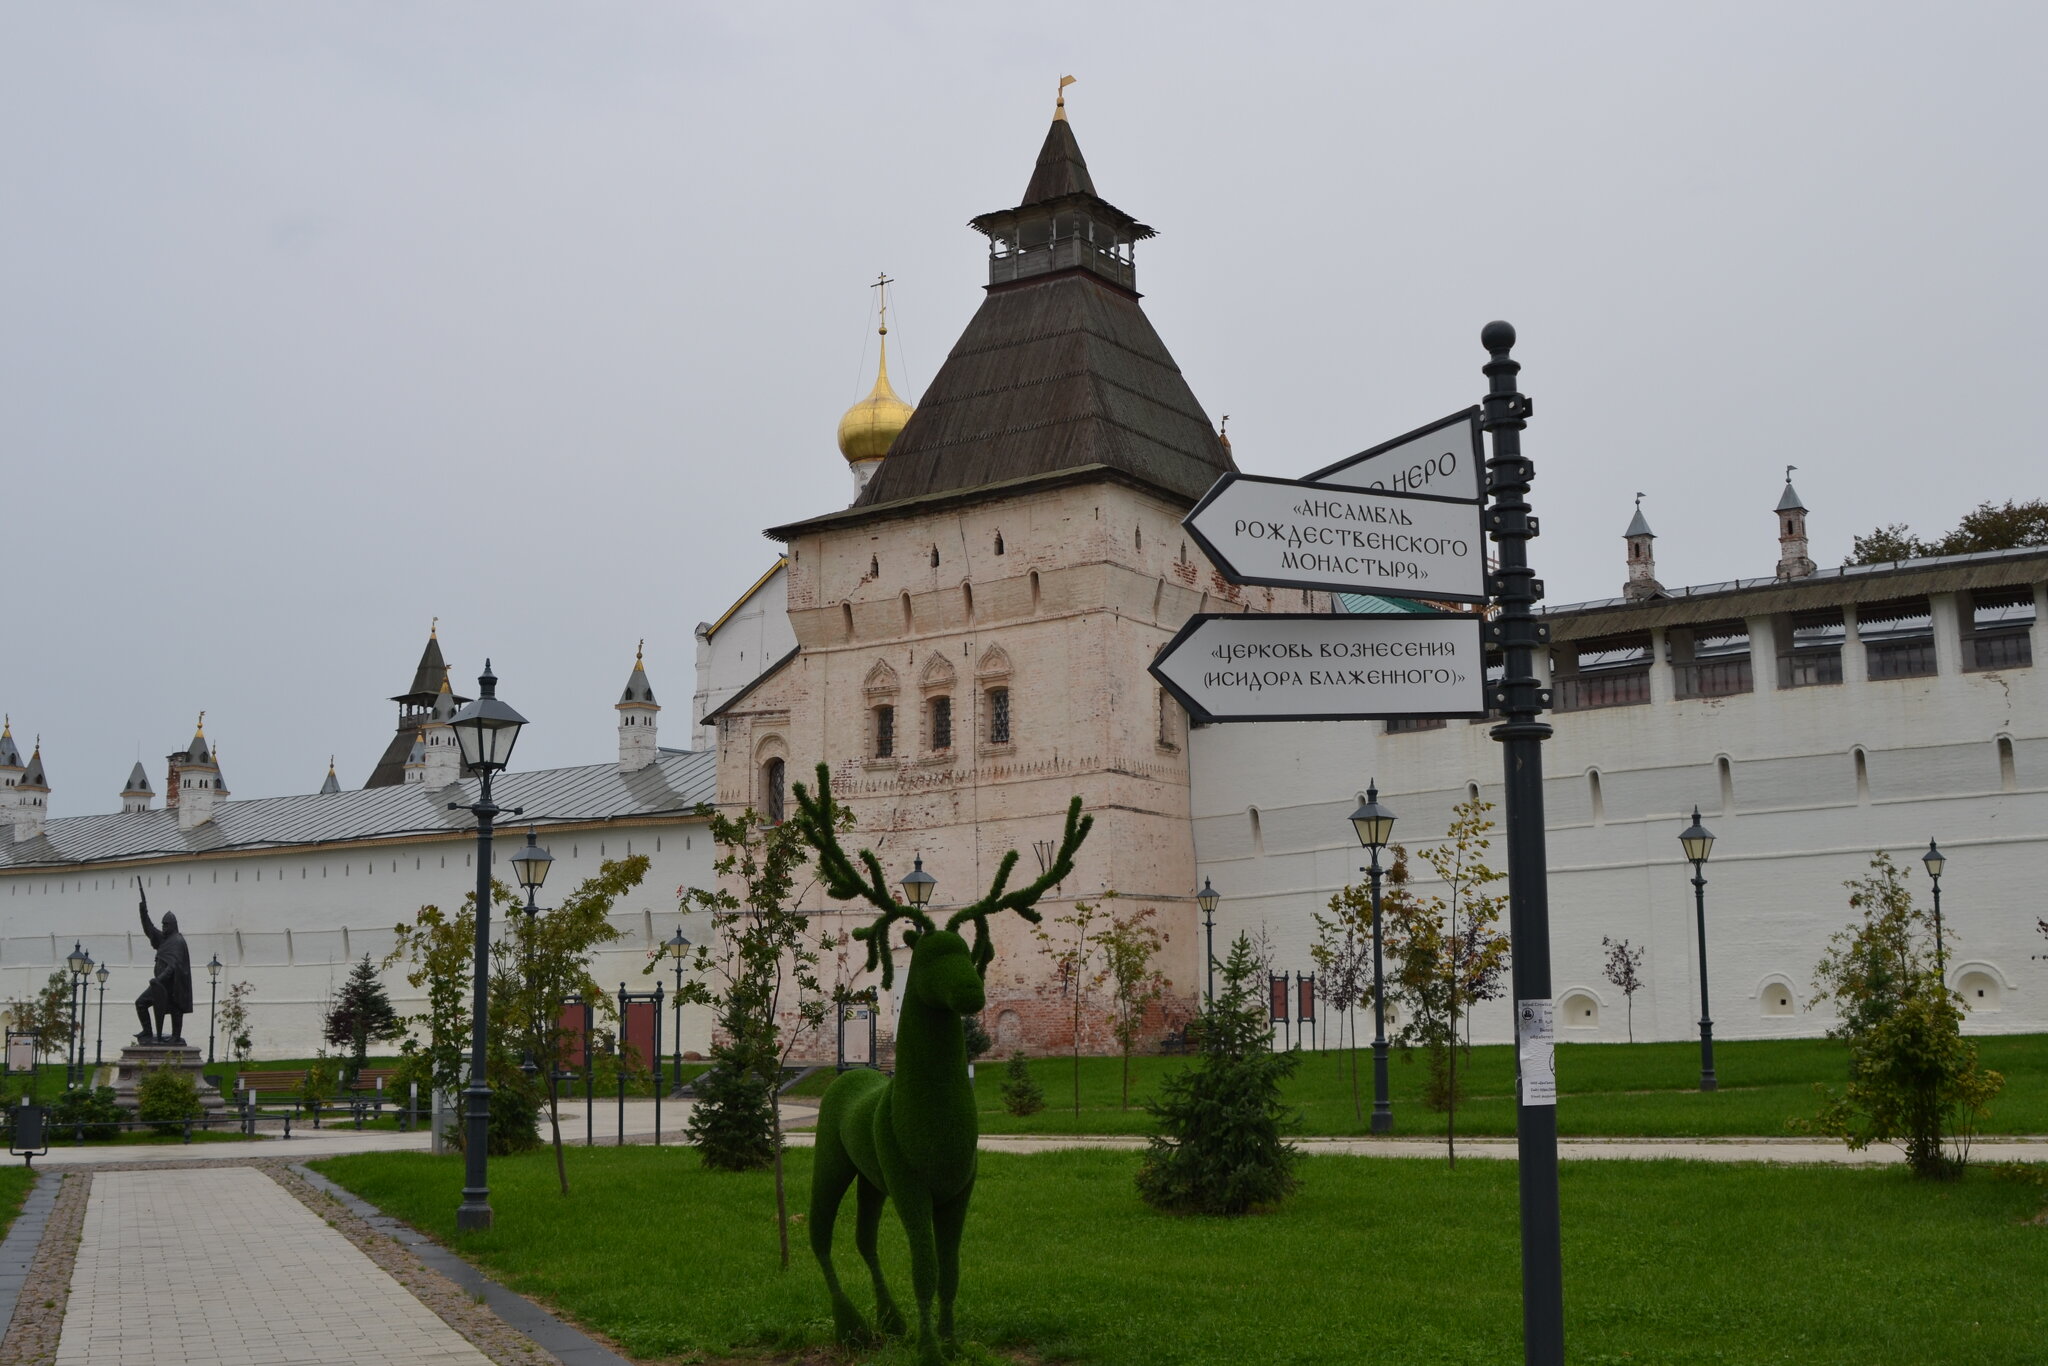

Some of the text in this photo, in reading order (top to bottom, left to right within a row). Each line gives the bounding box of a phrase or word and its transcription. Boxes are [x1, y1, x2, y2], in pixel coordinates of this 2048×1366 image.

[1393, 452, 1456, 492] НЕРО
[1293, 499, 1412, 525] «АНСАМБЛЬ
[1235, 519, 1467, 557] РОЖДЕСТВЕНСКОГО
[1281, 551, 1428, 579] МОНАСТЫРЯ»
[1211, 641, 1455, 664] «ЦЕРКОВЬ ВОЗНЕСЕНИЯ
[1204, 668, 1465, 691] (ИСИДОРА БЛАЖЕННОГО)»
